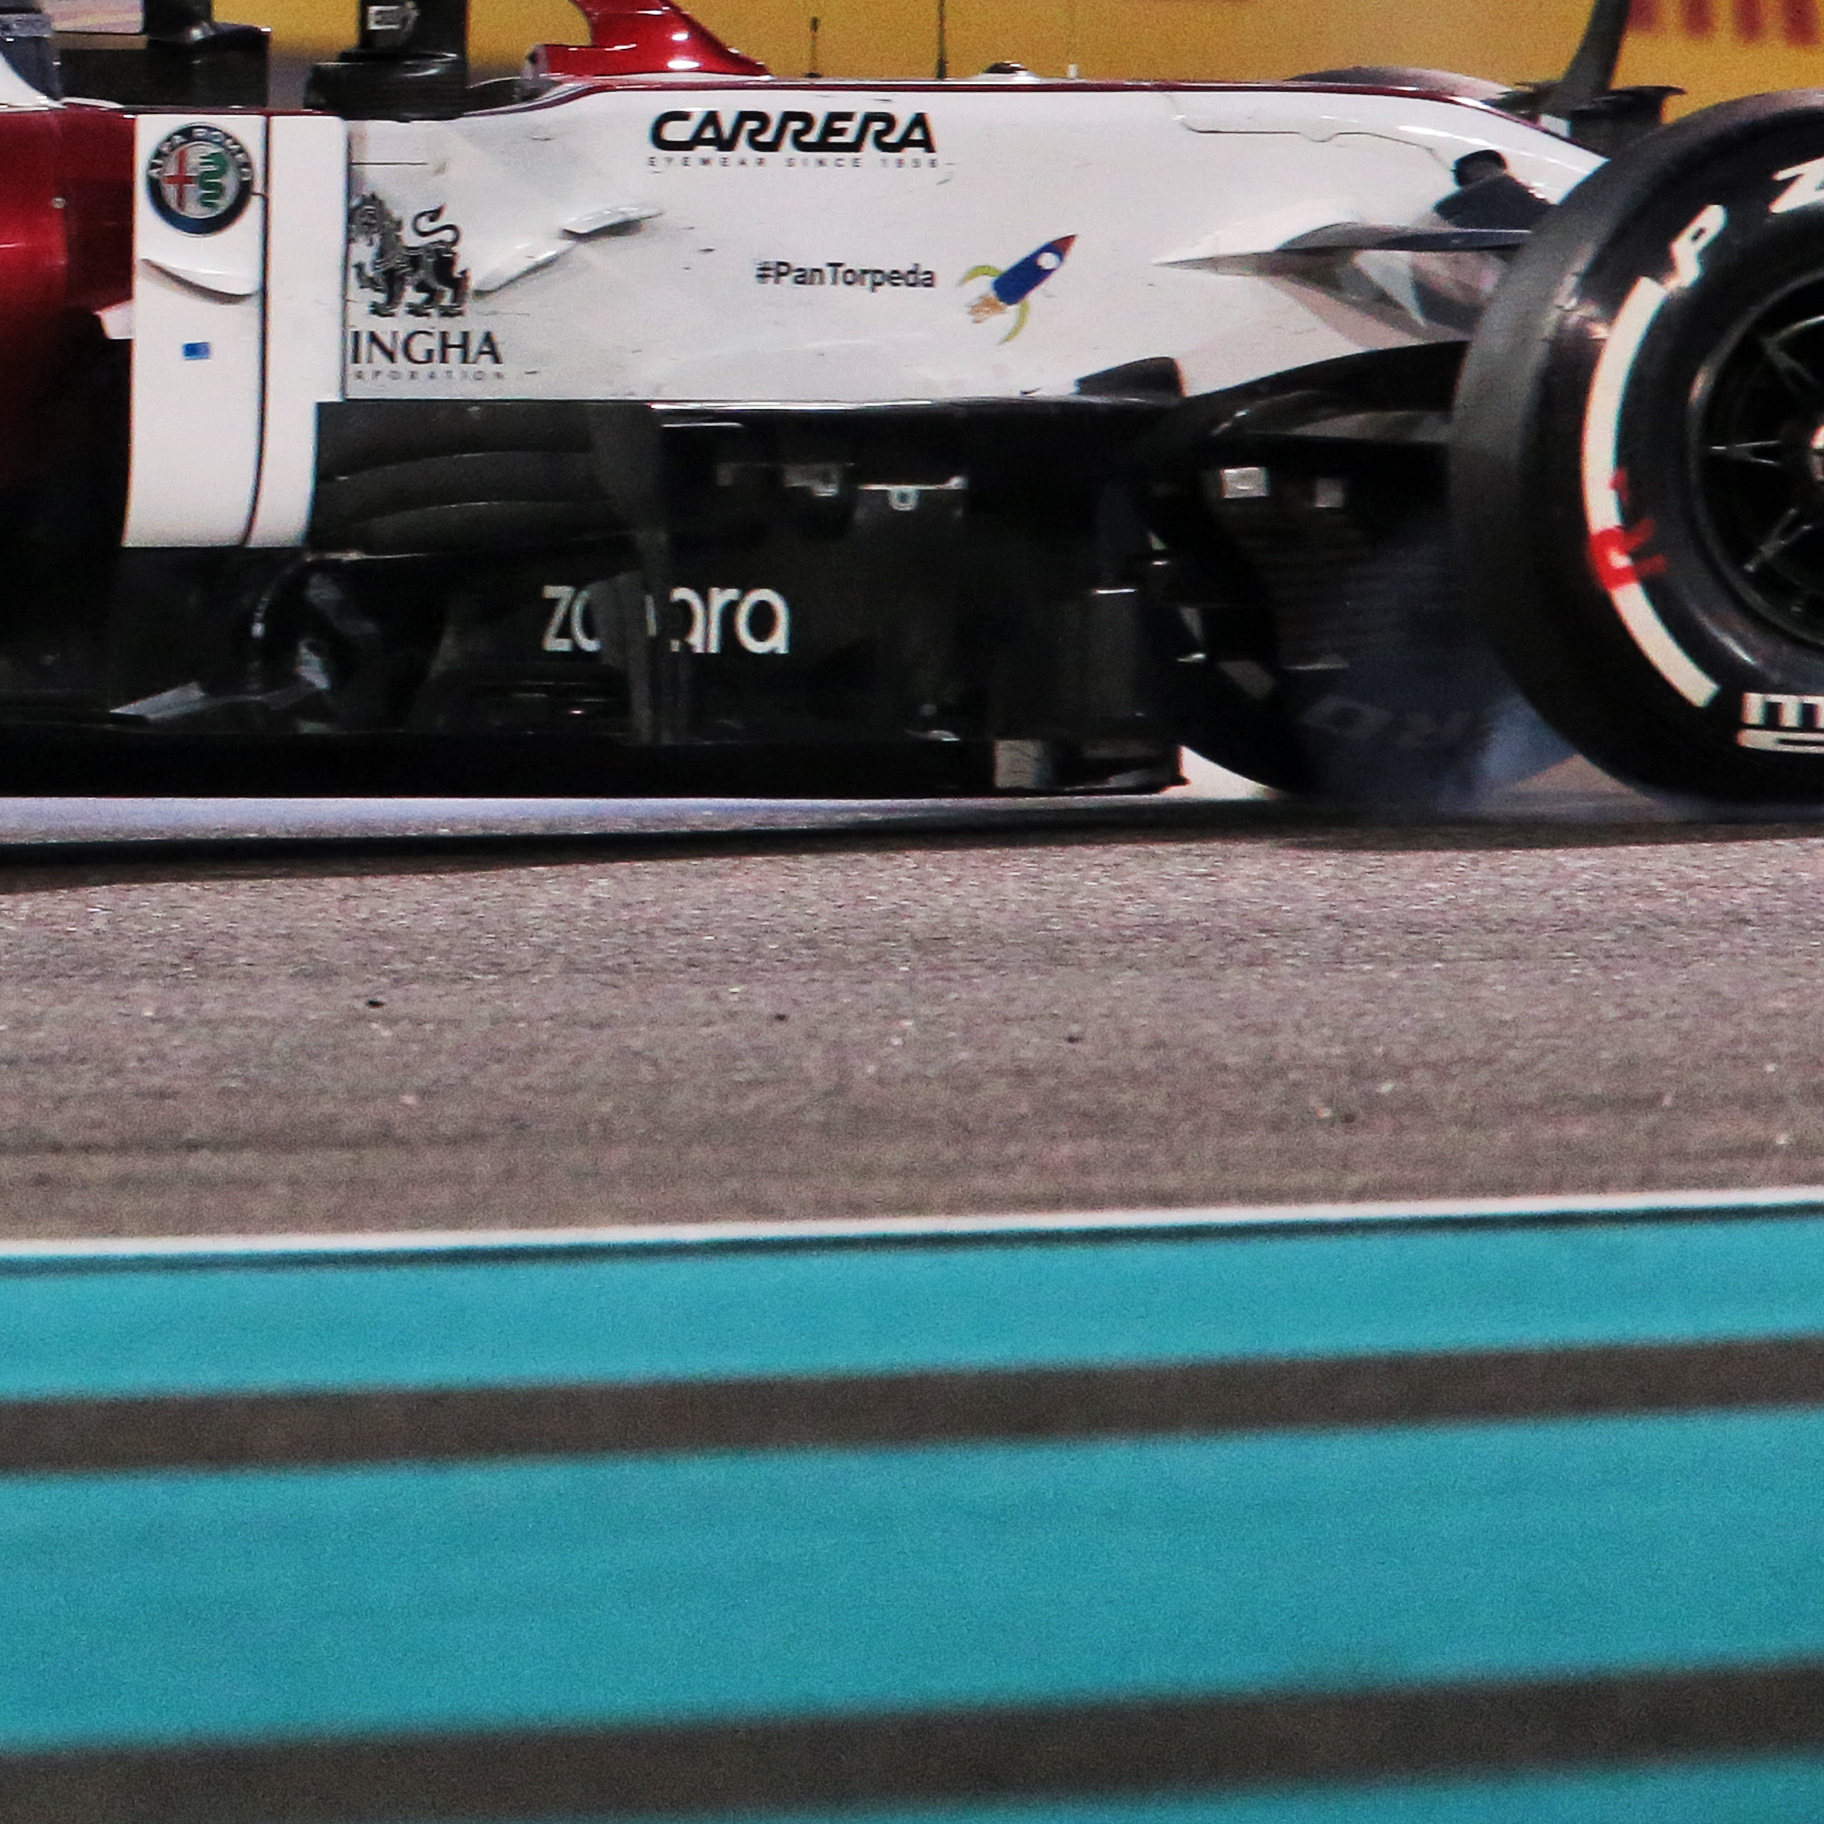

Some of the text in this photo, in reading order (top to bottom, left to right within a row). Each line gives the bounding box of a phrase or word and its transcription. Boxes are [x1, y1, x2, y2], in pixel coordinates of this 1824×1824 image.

[650, 109, 938, 154] CARRERA
[756, 261, 936, 292] #PanTorpeda
[350, 329, 504, 365] INGHA
